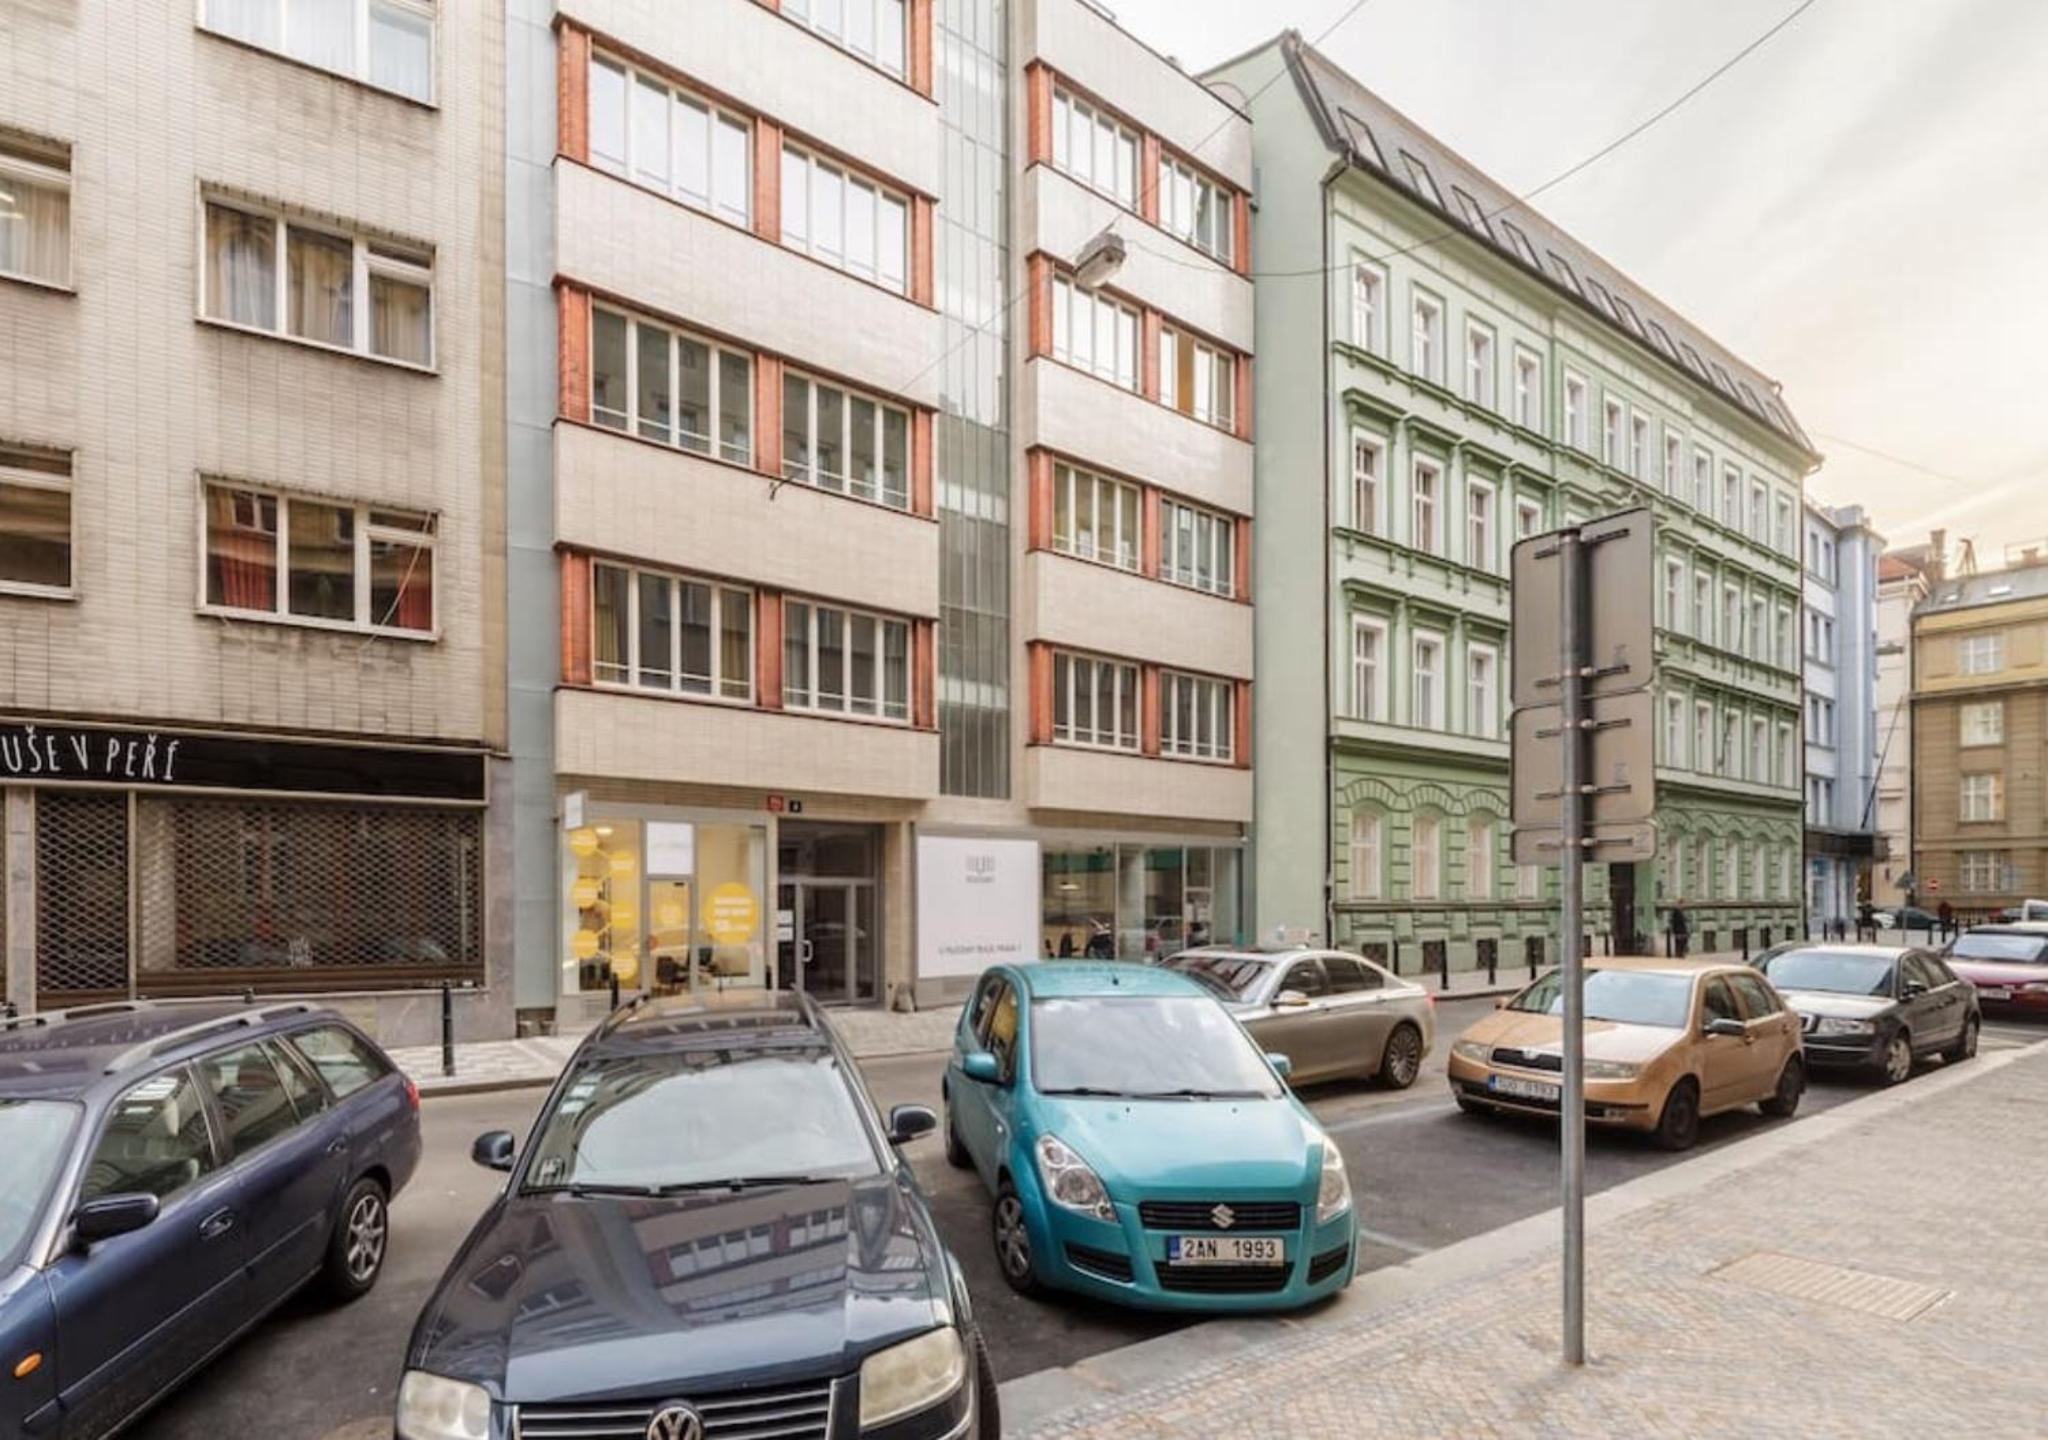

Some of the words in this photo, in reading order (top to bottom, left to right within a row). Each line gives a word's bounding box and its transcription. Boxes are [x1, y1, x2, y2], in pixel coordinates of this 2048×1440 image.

[70, 734, 89, 771] V
[106, 733, 180, 781] PEŘÍ
[1184, 1239, 1218, 1258] 2AN
[1232, 1239, 1277, 1259] 1993
